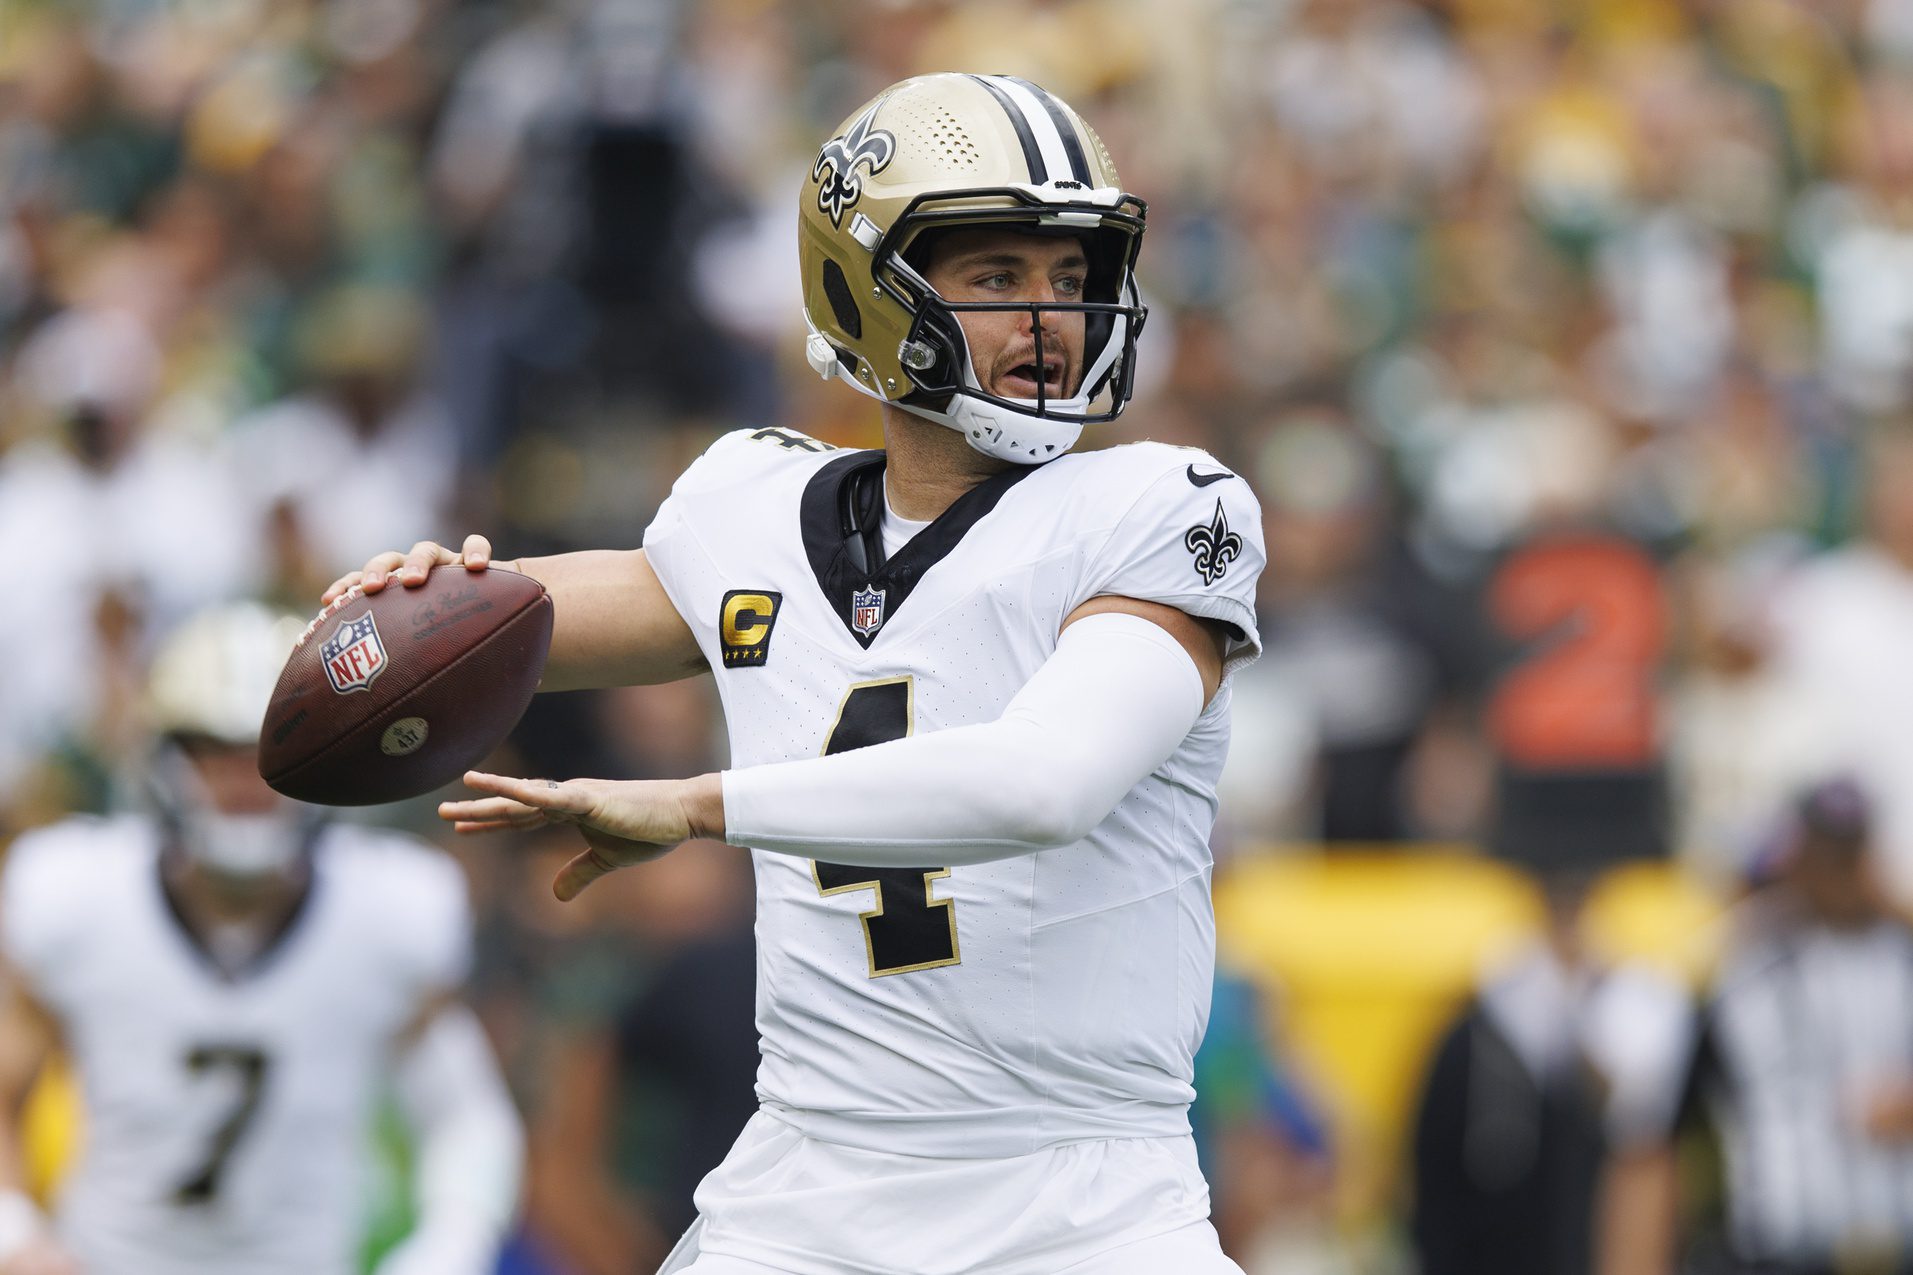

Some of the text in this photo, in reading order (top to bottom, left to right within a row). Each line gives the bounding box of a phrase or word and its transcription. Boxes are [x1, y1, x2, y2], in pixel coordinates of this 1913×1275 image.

[723, 594, 774, 646] C
[857, 608, 878, 628] NFL
[330, 640, 380, 687] NFL
[809, 674, 961, 979] 4
[180, 1042, 268, 1204] 7
